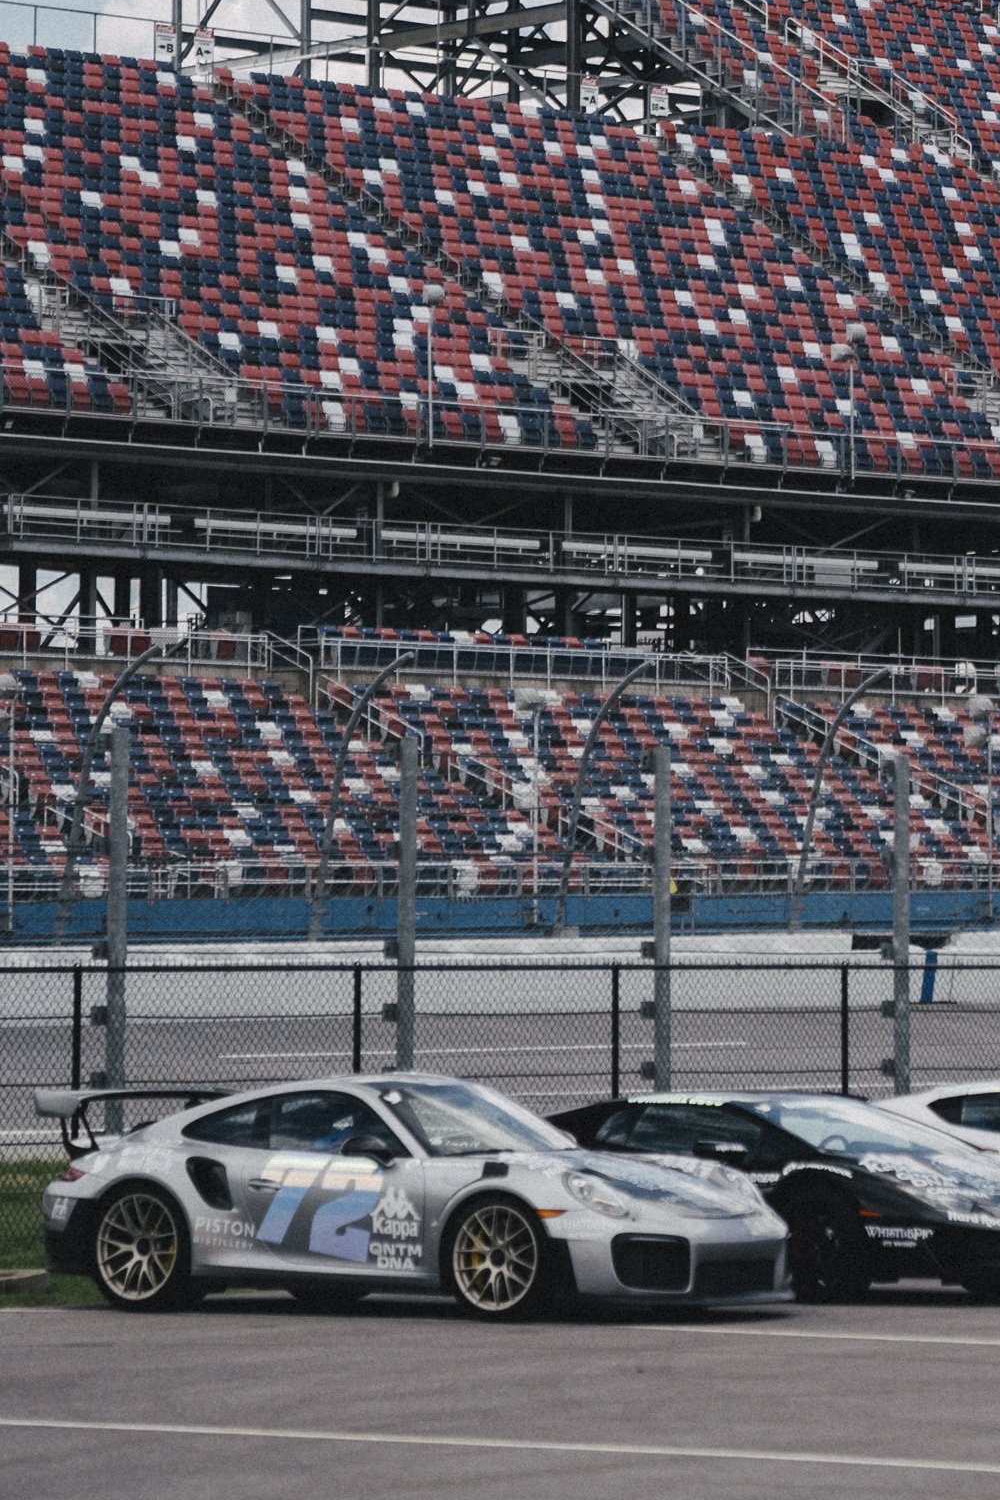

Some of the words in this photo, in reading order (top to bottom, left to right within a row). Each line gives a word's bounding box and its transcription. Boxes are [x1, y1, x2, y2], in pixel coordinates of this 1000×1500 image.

[166, 43, 174, 53] B
[195, 47, 204, 57] A
[589, 95, 597, 105] A
[256, 1150, 384, 1263] 72
[947, 1211, 978, 1224] Hard
[194, 1216, 256, 1238] PISTON
[372, 1214, 418, 1240] Kappa
[369, 1242, 422, 1258] QNTM
[377, 1255, 415, 1271] DNA
